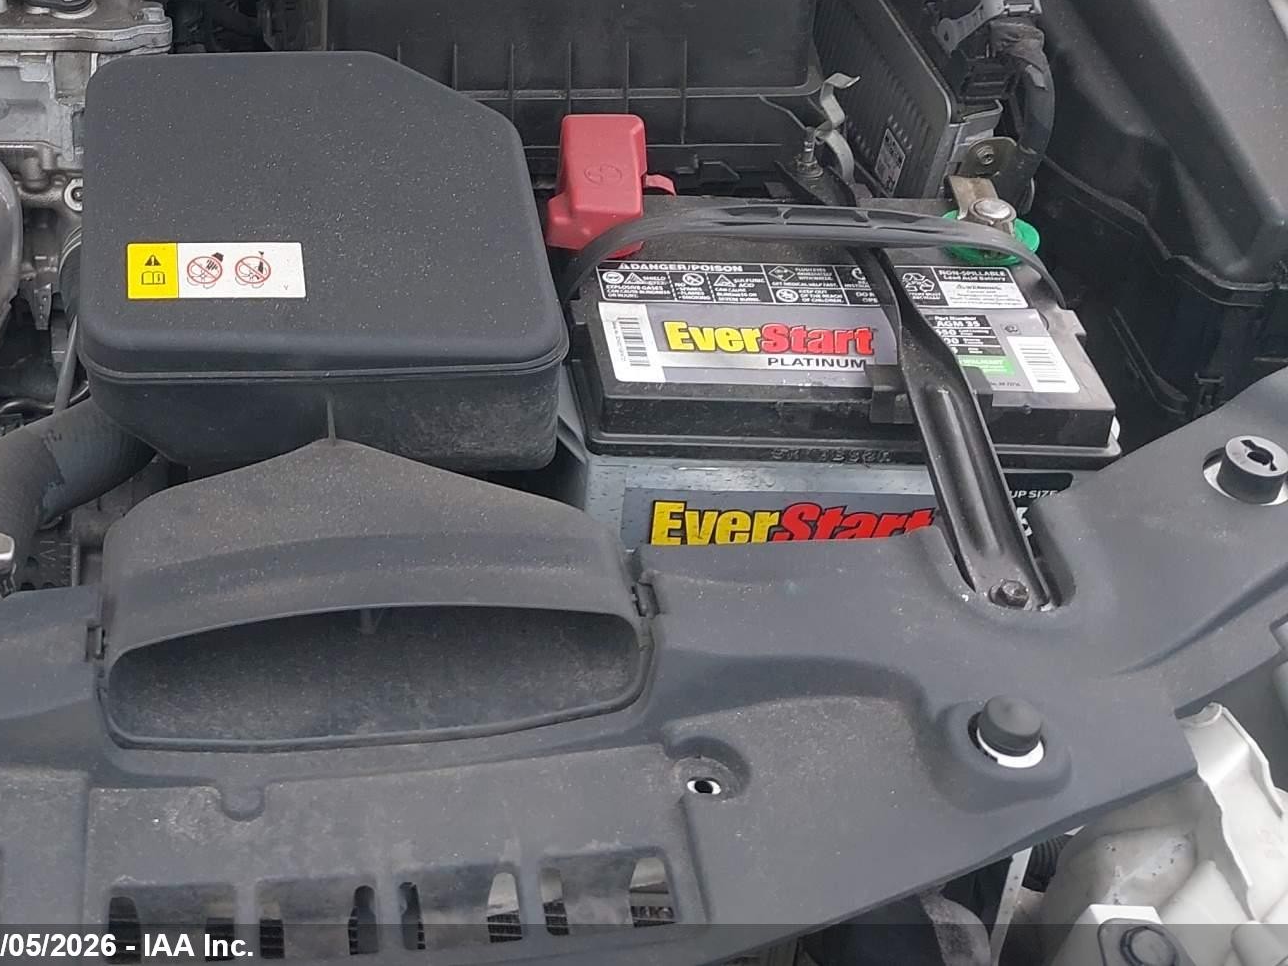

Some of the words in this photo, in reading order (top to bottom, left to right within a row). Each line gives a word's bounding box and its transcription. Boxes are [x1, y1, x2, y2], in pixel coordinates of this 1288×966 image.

[663, 321, 874, 356] EverStart
[767, 356, 867, 368] PLATINUM
[650, 500, 936, 546] EverStart
